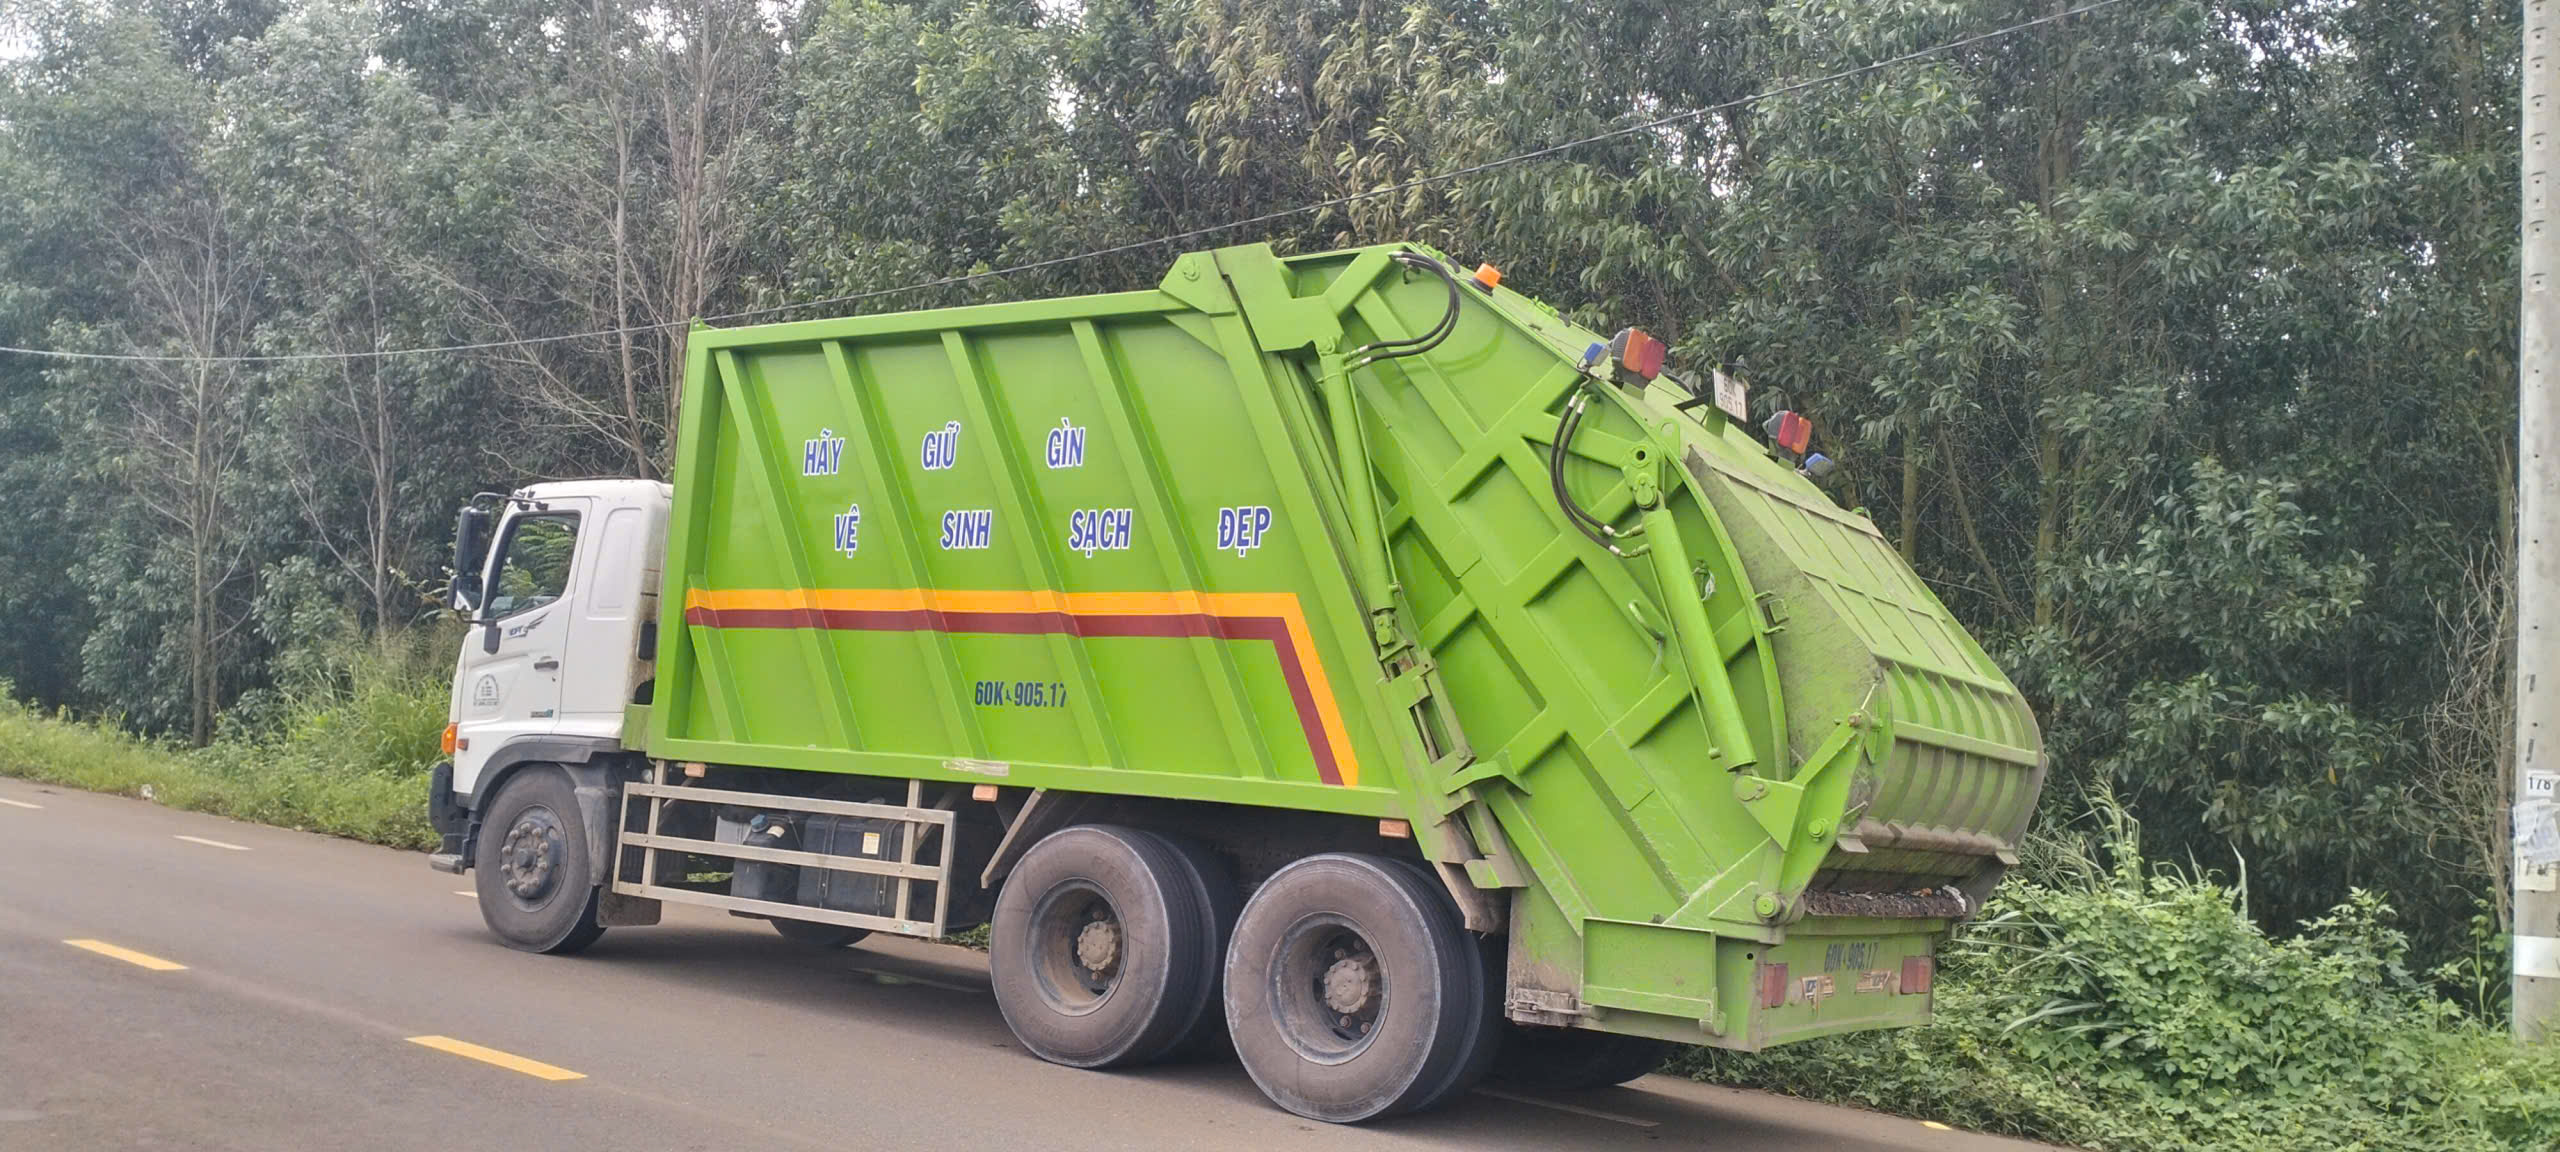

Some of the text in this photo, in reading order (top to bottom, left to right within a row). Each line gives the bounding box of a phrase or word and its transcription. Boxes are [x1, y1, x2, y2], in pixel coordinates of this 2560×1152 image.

[803, 417, 1086, 476] HÃY GIỮ GÌN
[834, 504, 1272, 558] VỆ SINH SẠCH ĐẸP
